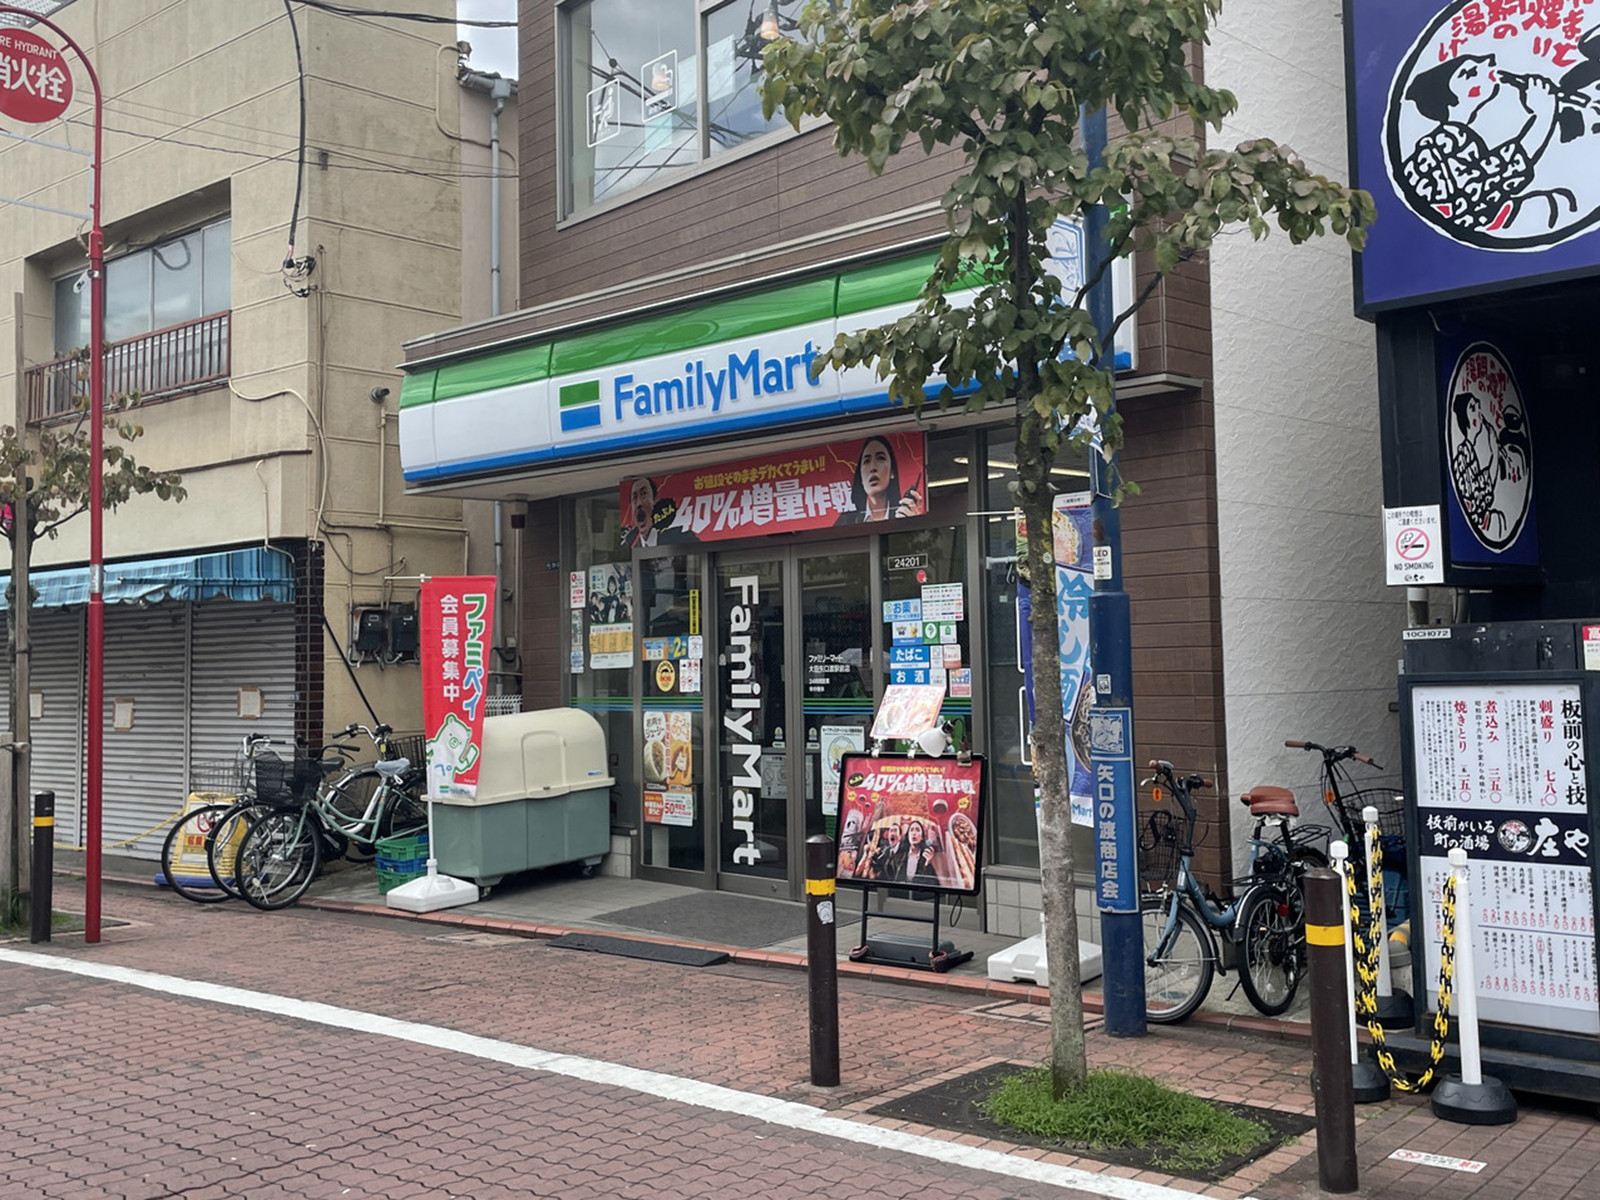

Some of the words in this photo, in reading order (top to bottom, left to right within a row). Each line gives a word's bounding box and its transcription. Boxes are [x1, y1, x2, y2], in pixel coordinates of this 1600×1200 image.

[14, 39, 58, 60] HYDRANT
[613, 341, 821, 421] FamilyMart
[674, 478, 857, 535] 40%増量作戦
[895, 556, 920, 568] 24201
[1394, 562, 1403, 572] NO
[1404, 561, 1435, 571] SMOKING
[440, 593, 461, 703] 会員募集中
[463, 593, 487, 721] ファミペイ
[808, 653, 844, 663] ファミリーマート
[896, 648, 924, 662] たばこ
[724, 575, 762, 866] FamilyMart
[1454, 700, 1468, 754] 焼きとり
[1485, 700, 1500, 744] 煮込み
[1539, 699, 1555, 745] 刺盛り
[1560, 699, 1587, 806] 板前の心と技
[1071, 803, 1093, 818] Mart
[1097, 762, 1120, 899] 矢口の渡商店会
[1426, 813, 1496, 835] 板前がいる
[1433, 832, 1491, 852] 町の酒場
[1526, 817, 1590, 859] 庄や
